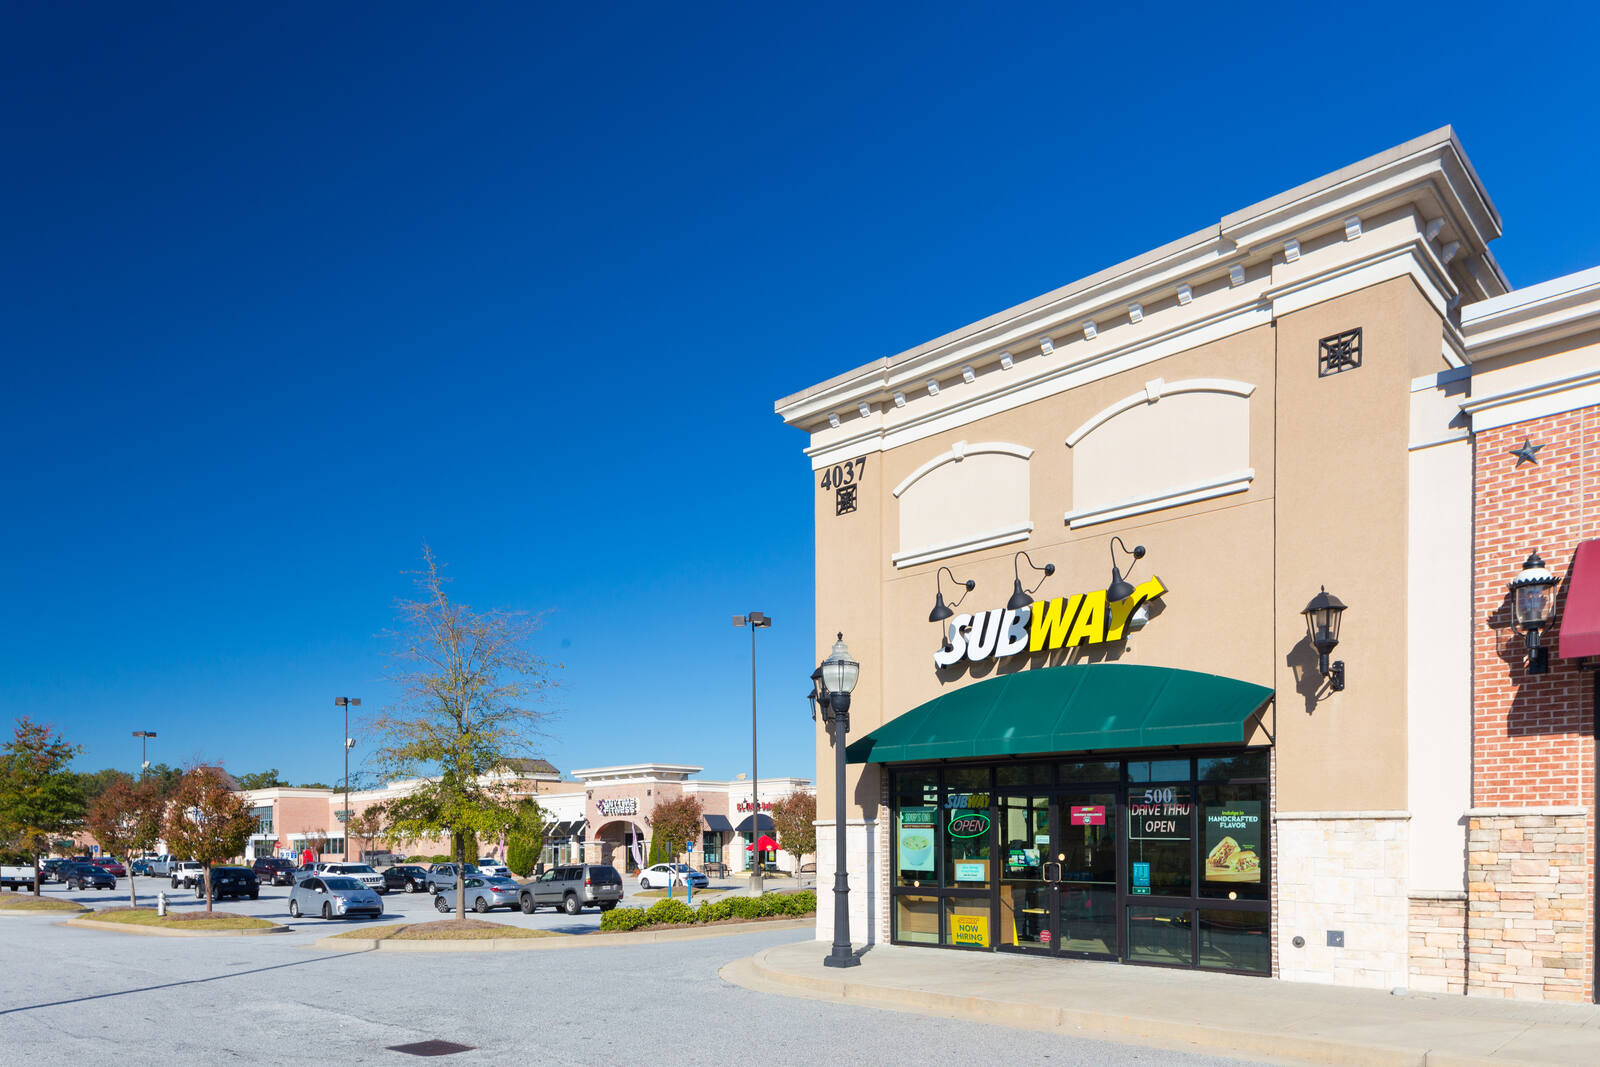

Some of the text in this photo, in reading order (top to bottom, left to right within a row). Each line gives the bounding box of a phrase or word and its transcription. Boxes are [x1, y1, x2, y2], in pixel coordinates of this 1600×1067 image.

[820, 456, 867, 491] 4037
[932, 574, 1169, 668] SUBWAY
[944, 794, 990, 808] SUBWAY
[1144, 788, 1172, 804] 500
[1131, 804, 1191, 816] DRIVE THRU
[953, 819, 985, 832] OPEN
[1145, 820, 1176, 833] OPEN
[959, 924, 979, 932] NOW
[956, 932, 983, 942] HIRING
